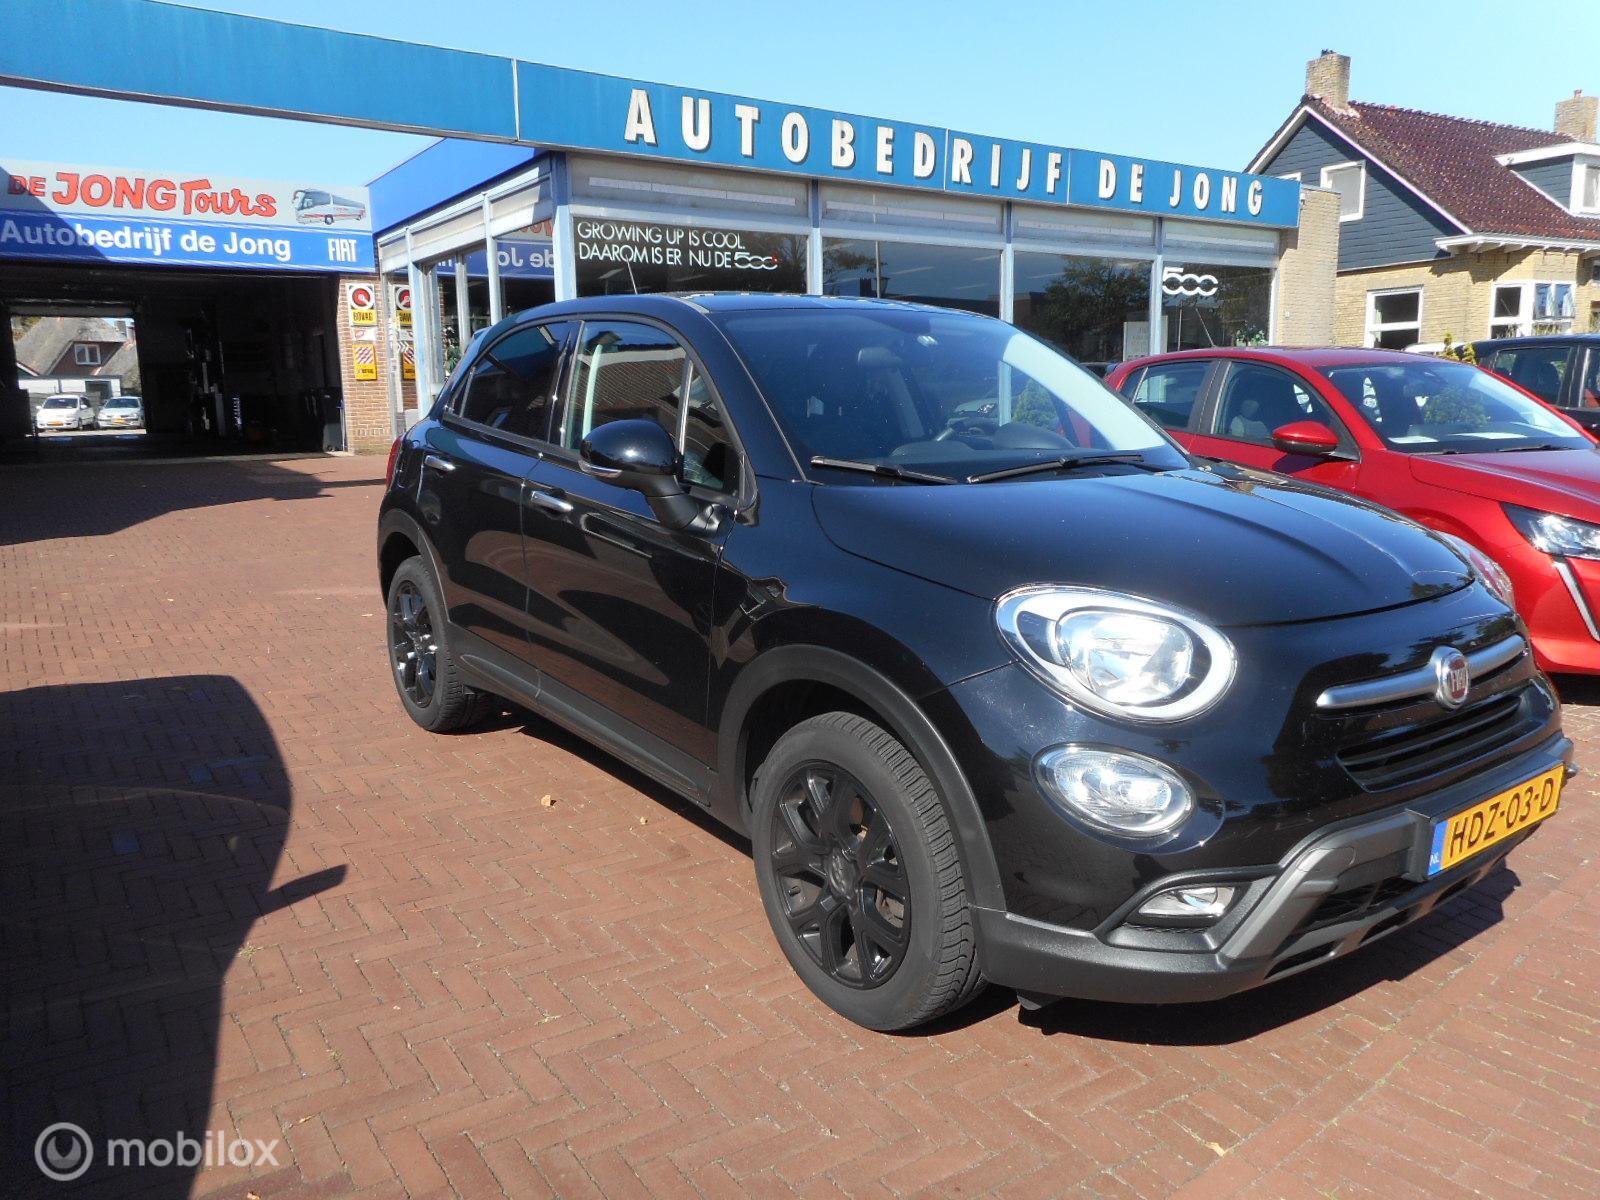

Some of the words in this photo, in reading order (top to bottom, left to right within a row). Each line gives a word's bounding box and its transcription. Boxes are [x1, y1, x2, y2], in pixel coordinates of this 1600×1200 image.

[624, 88, 1063, 194] AUTOBEDRIJF
[1099, 159, 1144, 203] DE
[1169, 169, 1264, 216] JONG
[7, 174, 46, 197] DE
[52, 171, 177, 211] JONG
[180, 178, 277, 218] Tours
[0, 219, 172, 256] Autobedrijf
[180, 229, 216, 252] de
[223, 231, 292, 262] Jong
[327, 238, 358, 262] FIAT
[577, 221, 662, 244] GROWING
[665, 229, 685, 246] UP
[688, 229, 700, 247] IS
[702, 230, 746, 250] COOL.
[578, 242, 649, 265] DAAROM
[651, 245, 663, 264] IS
[666, 246, 683, 266] ER
[689, 250, 712, 267] NU
[714, 251, 732, 268] DE
[1162, 266, 1219, 296] 500
[1449, 777, 1554, 858] HDZ-03-D
